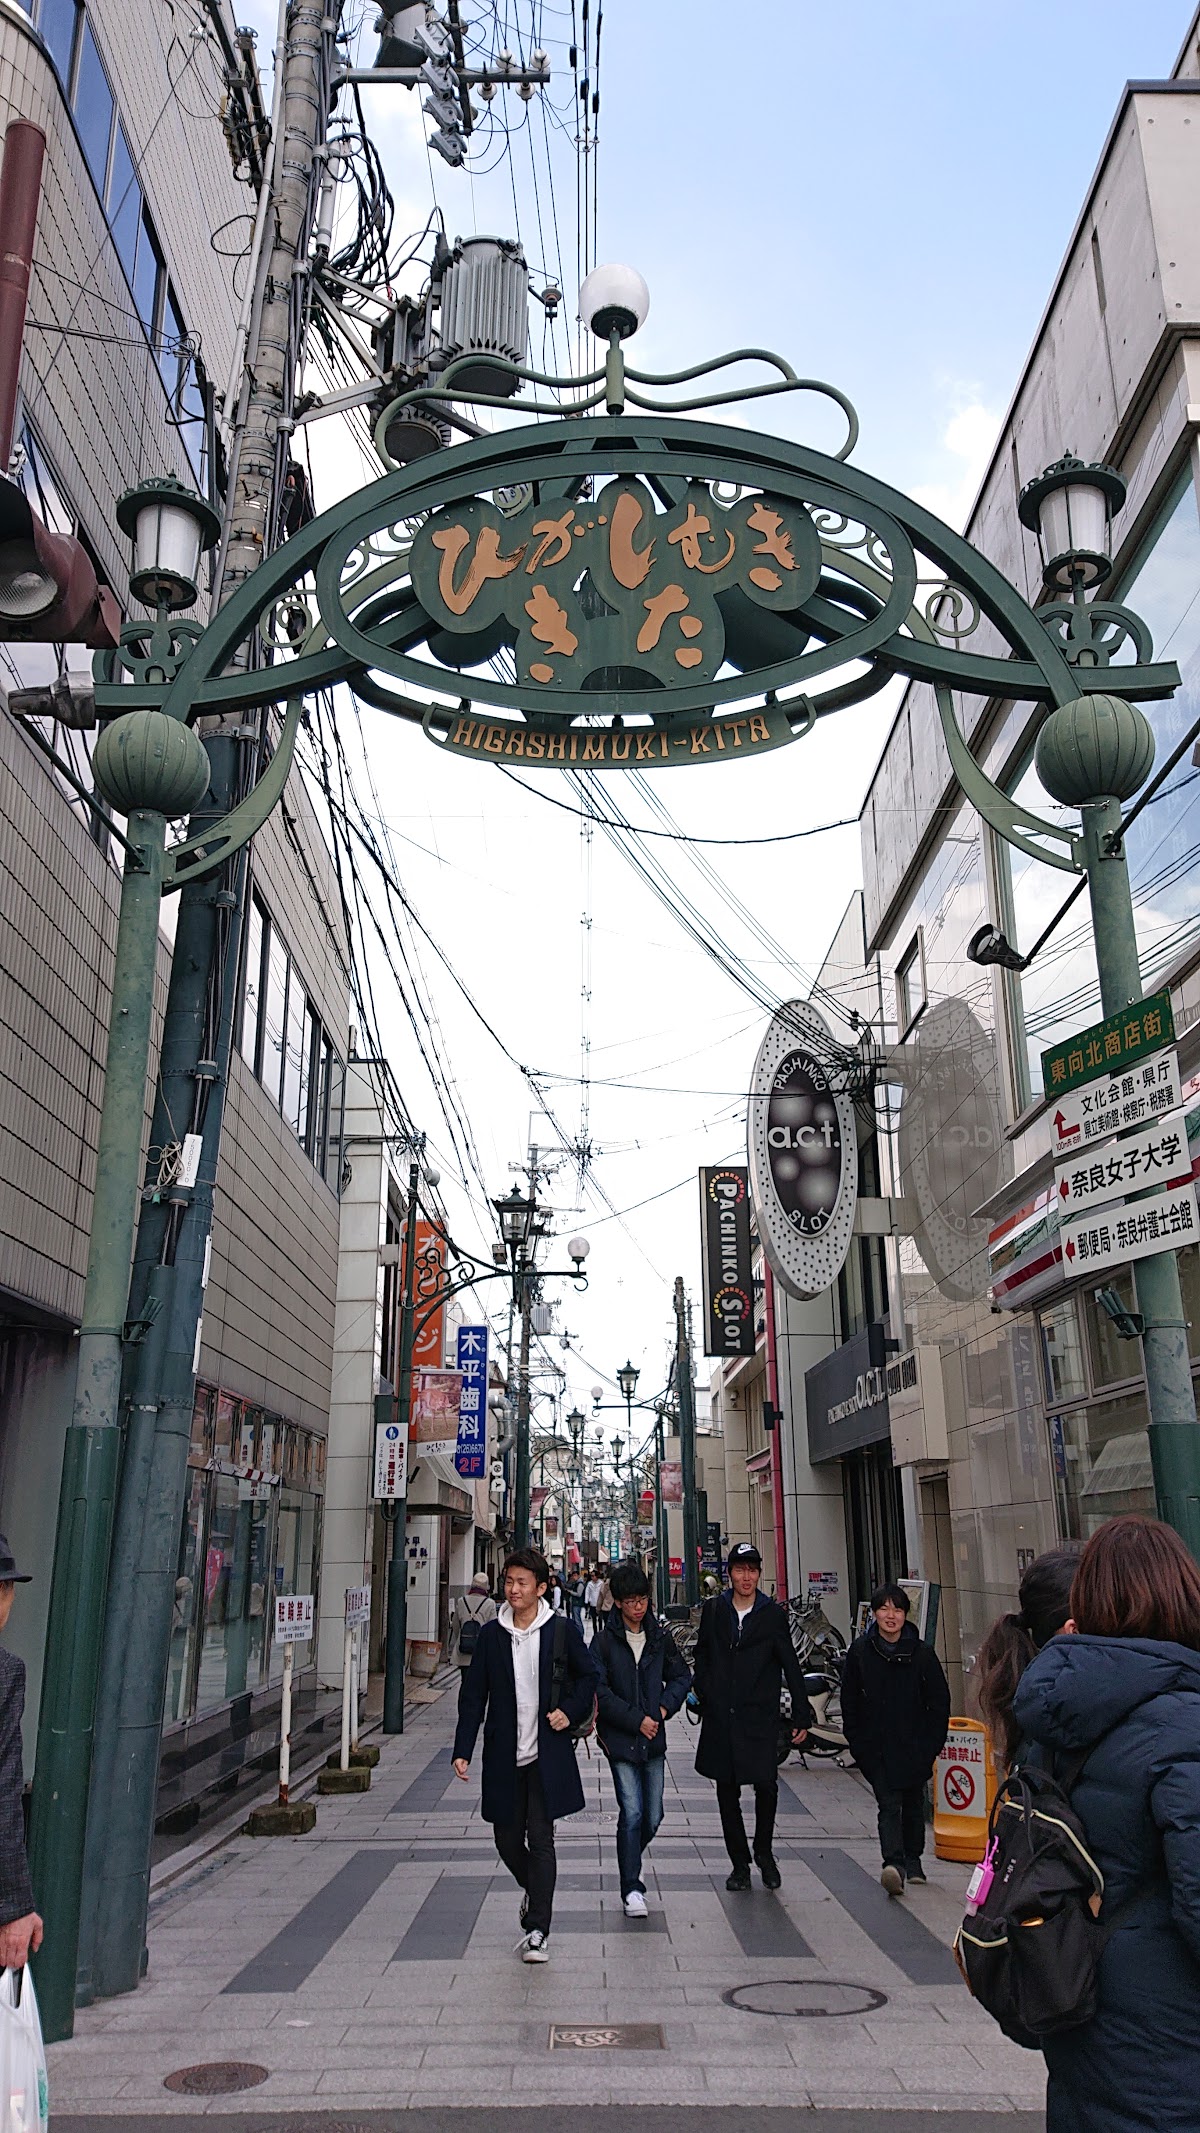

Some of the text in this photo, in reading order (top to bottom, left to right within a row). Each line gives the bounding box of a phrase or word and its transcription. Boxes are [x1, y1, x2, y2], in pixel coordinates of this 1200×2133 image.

[431, 493, 801, 615] ひがしむき
[523, 584, 703, 684] きた
[452, 714, 771, 760] HIGASHIMUKI-KITA
[774, 1057, 827, 1092] PACHINKO
[1050, 1008, 1162, 1085] 東向北商店街
[1080, 1060, 1171, 1116] 文化会館・県庁
[767, 1120, 841, 1149] a.c.t.
[1072, 1133, 1182, 1199] 奈良女子大学
[788, 1207, 832, 1231] SLOT
[1077, 1200, 1194, 1261] 郵便局・奈良弁護士会館
[717, 1183, 743, 1350] PACHINKO SLOT
[459, 1331, 481, 1440] 木平歯科
[459, 1457, 481, 1473] 2F
